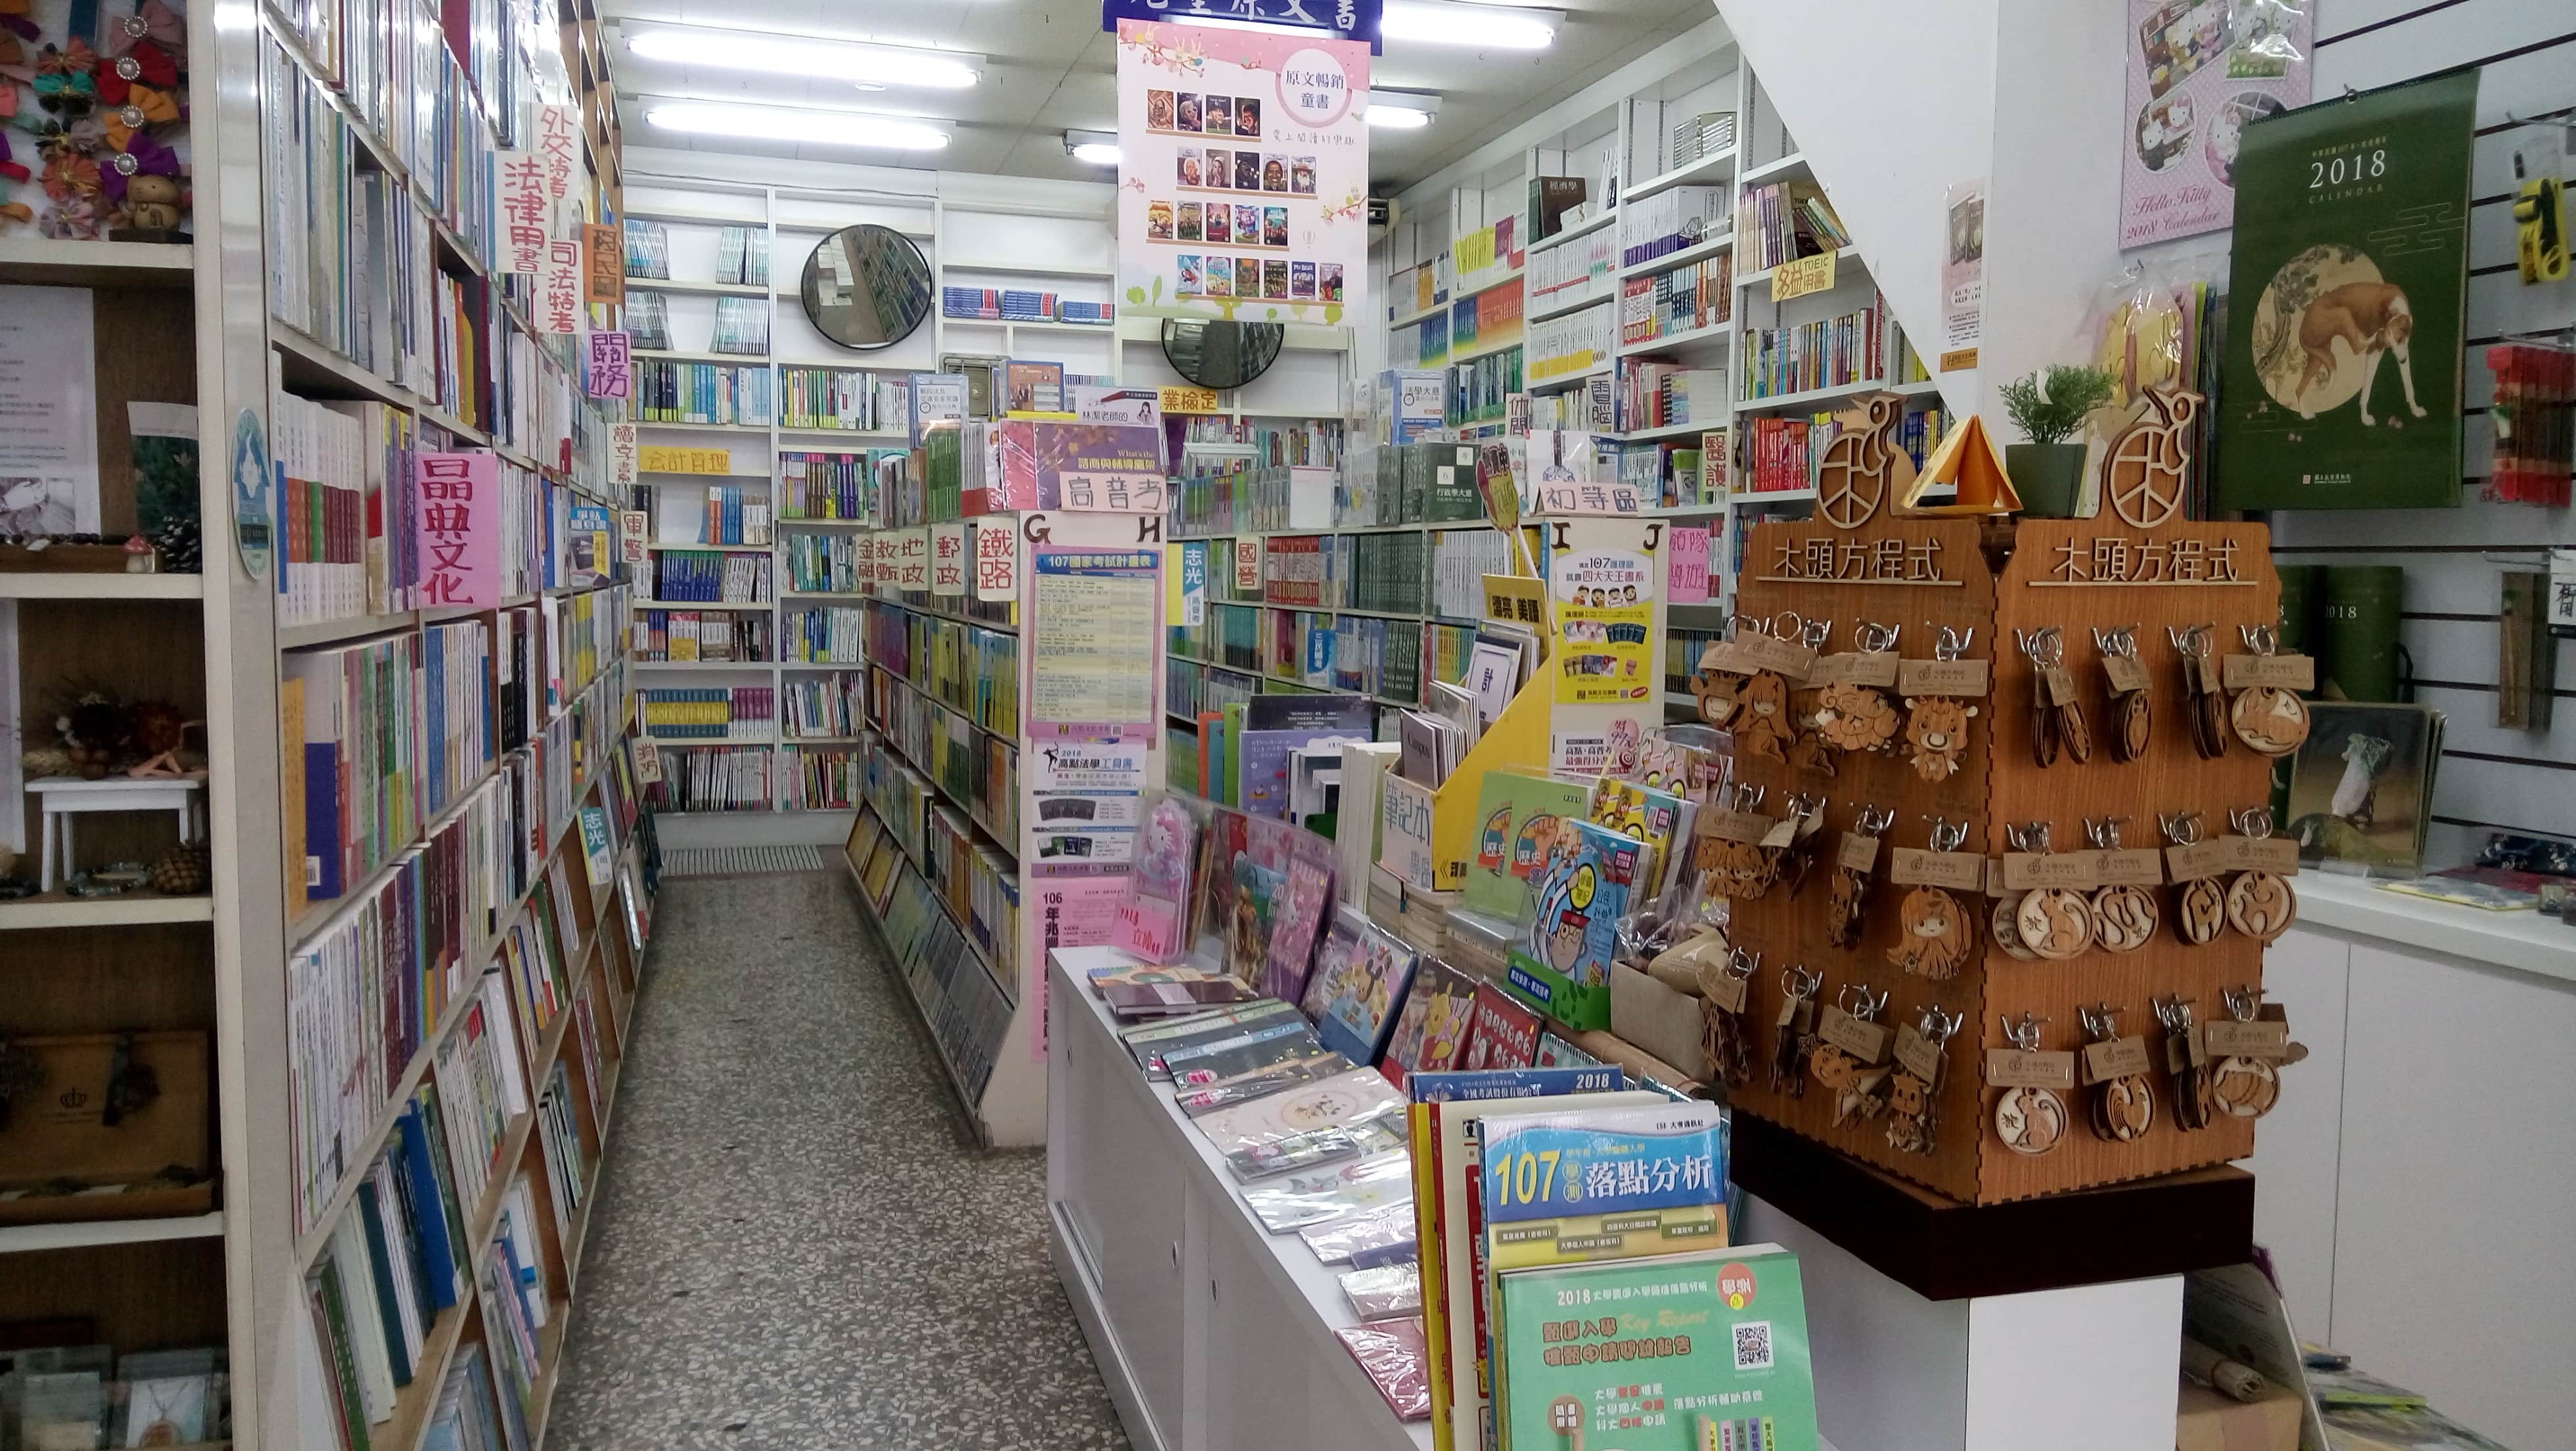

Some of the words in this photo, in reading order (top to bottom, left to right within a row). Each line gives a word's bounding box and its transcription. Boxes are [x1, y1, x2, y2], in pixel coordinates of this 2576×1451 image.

[1286, 70, 1344, 89] 原文暢銷
[1300, 93, 1329, 109] 童書
[540, 105, 574, 199] 外交特考
[2309, 150, 2386, 189] 2018
[2133, 194, 2176, 216] Hello
[2176, 185, 2211, 204] Kitty
[2309, 183, 2383, 204] CALENDAR
[504, 156, 547, 272] 法律用書
[2127, 220, 2158, 239] 2018
[2162, 206, 2219, 231] Calendar
[1804, 257, 1829, 269] TOEIC
[547, 241, 577, 333] 司法特考
[590, 333, 629, 397] 關務
[1162, 388, 1216, 411] 業檢定
[1591, 380, 1612, 424] 電腦
[1069, 476, 1162, 511] 高普考
[1546, 486, 1638, 511] 初等區
[421, 459, 473, 605] 晶典文化
[1023, 514, 1051, 544] G
[1136, 517, 1161, 542] H
[1551, 522, 1571, 549] I
[1643, 524, 1663, 550] J
[900, 538, 925, 585] 地政
[936, 536, 961, 586] 郵政
[978, 528, 1013, 589] 鐵路
[1185, 549, 1203, 584] 志光
[1773, 538, 1942, 582] 木頭方程式
[2053, 538, 2241, 583] 木頭方程式
[2326, 605, 2357, 618] 018
[584, 812, 605, 846] 志光
[1385, 779, 1431, 847] 筆記本
[1576, 1072, 1609, 1089] 2018
[1496, 1150, 1561, 1207] 107
[1586, 1155, 1711, 1199] 落點分析
[1557, 1288, 1591, 1306] 2018
